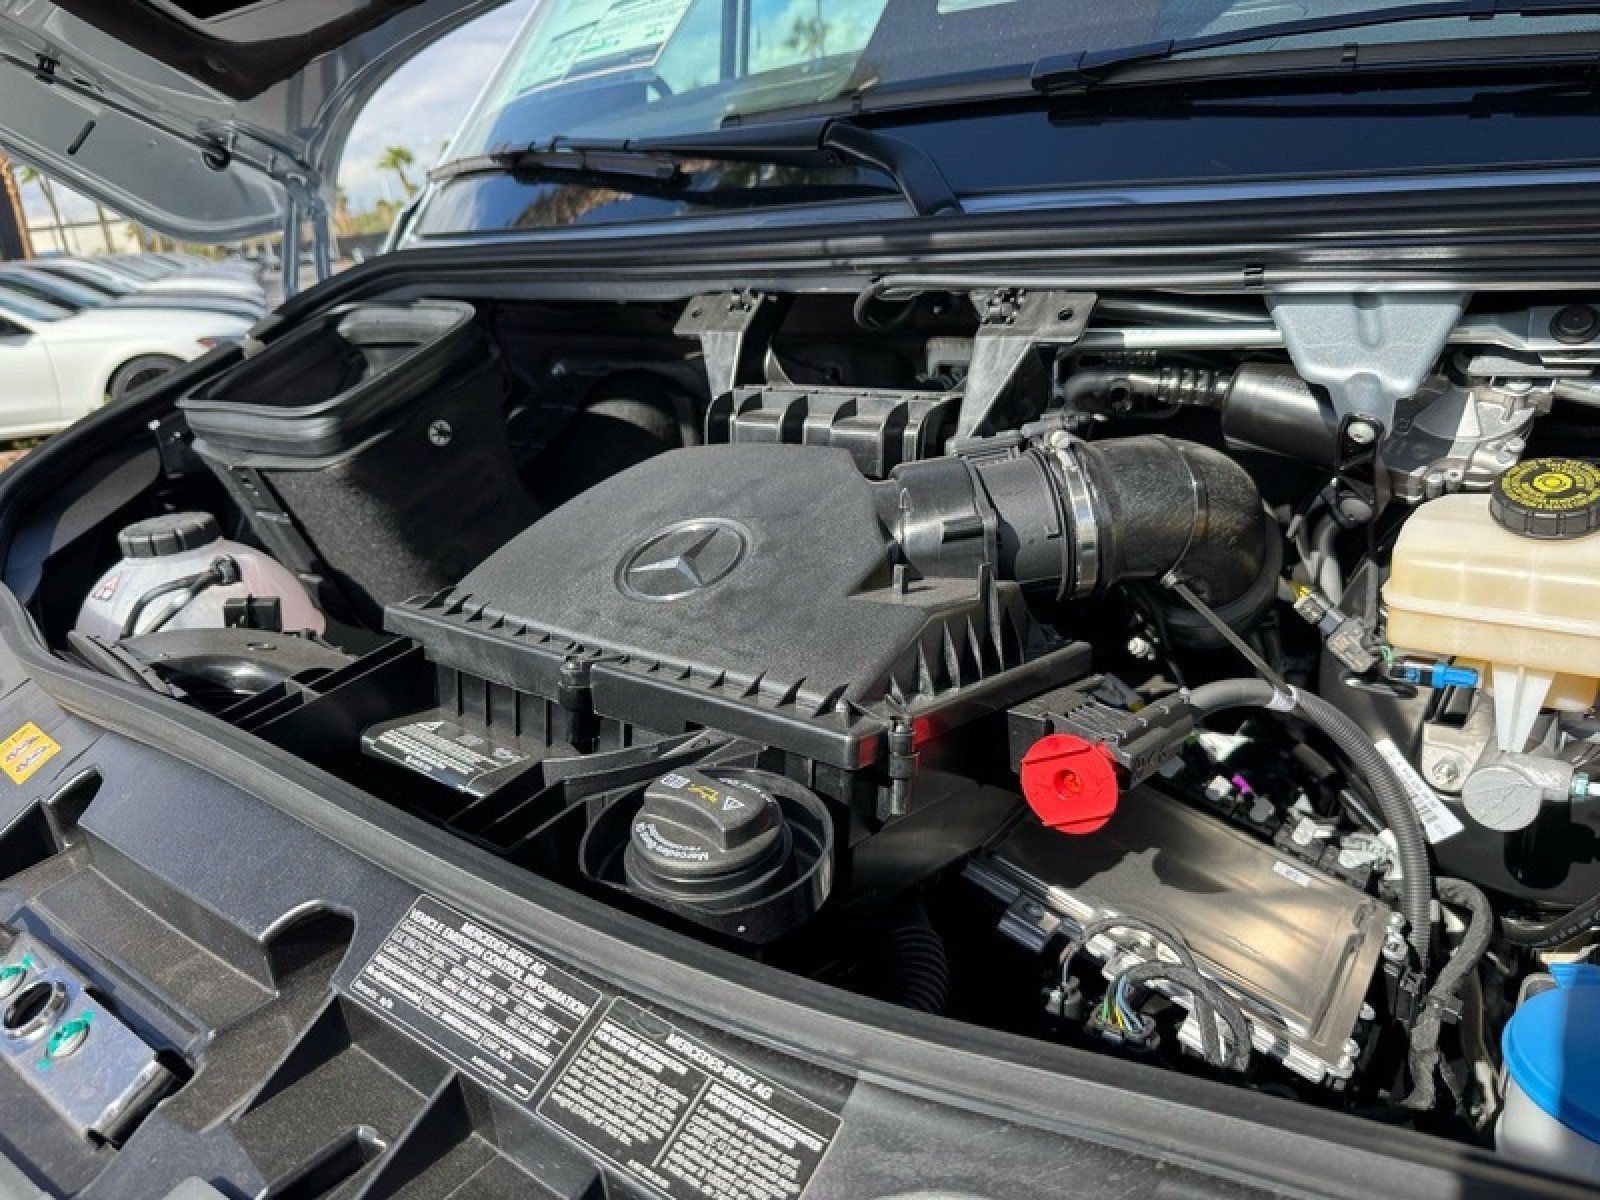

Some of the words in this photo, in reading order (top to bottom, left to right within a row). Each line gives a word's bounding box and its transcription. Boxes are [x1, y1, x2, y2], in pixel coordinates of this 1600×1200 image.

[480, 949, 525, 980] CONTROL
[522, 973, 590, 1017] INFORMATION
[751, 1081, 775, 1100] AG
